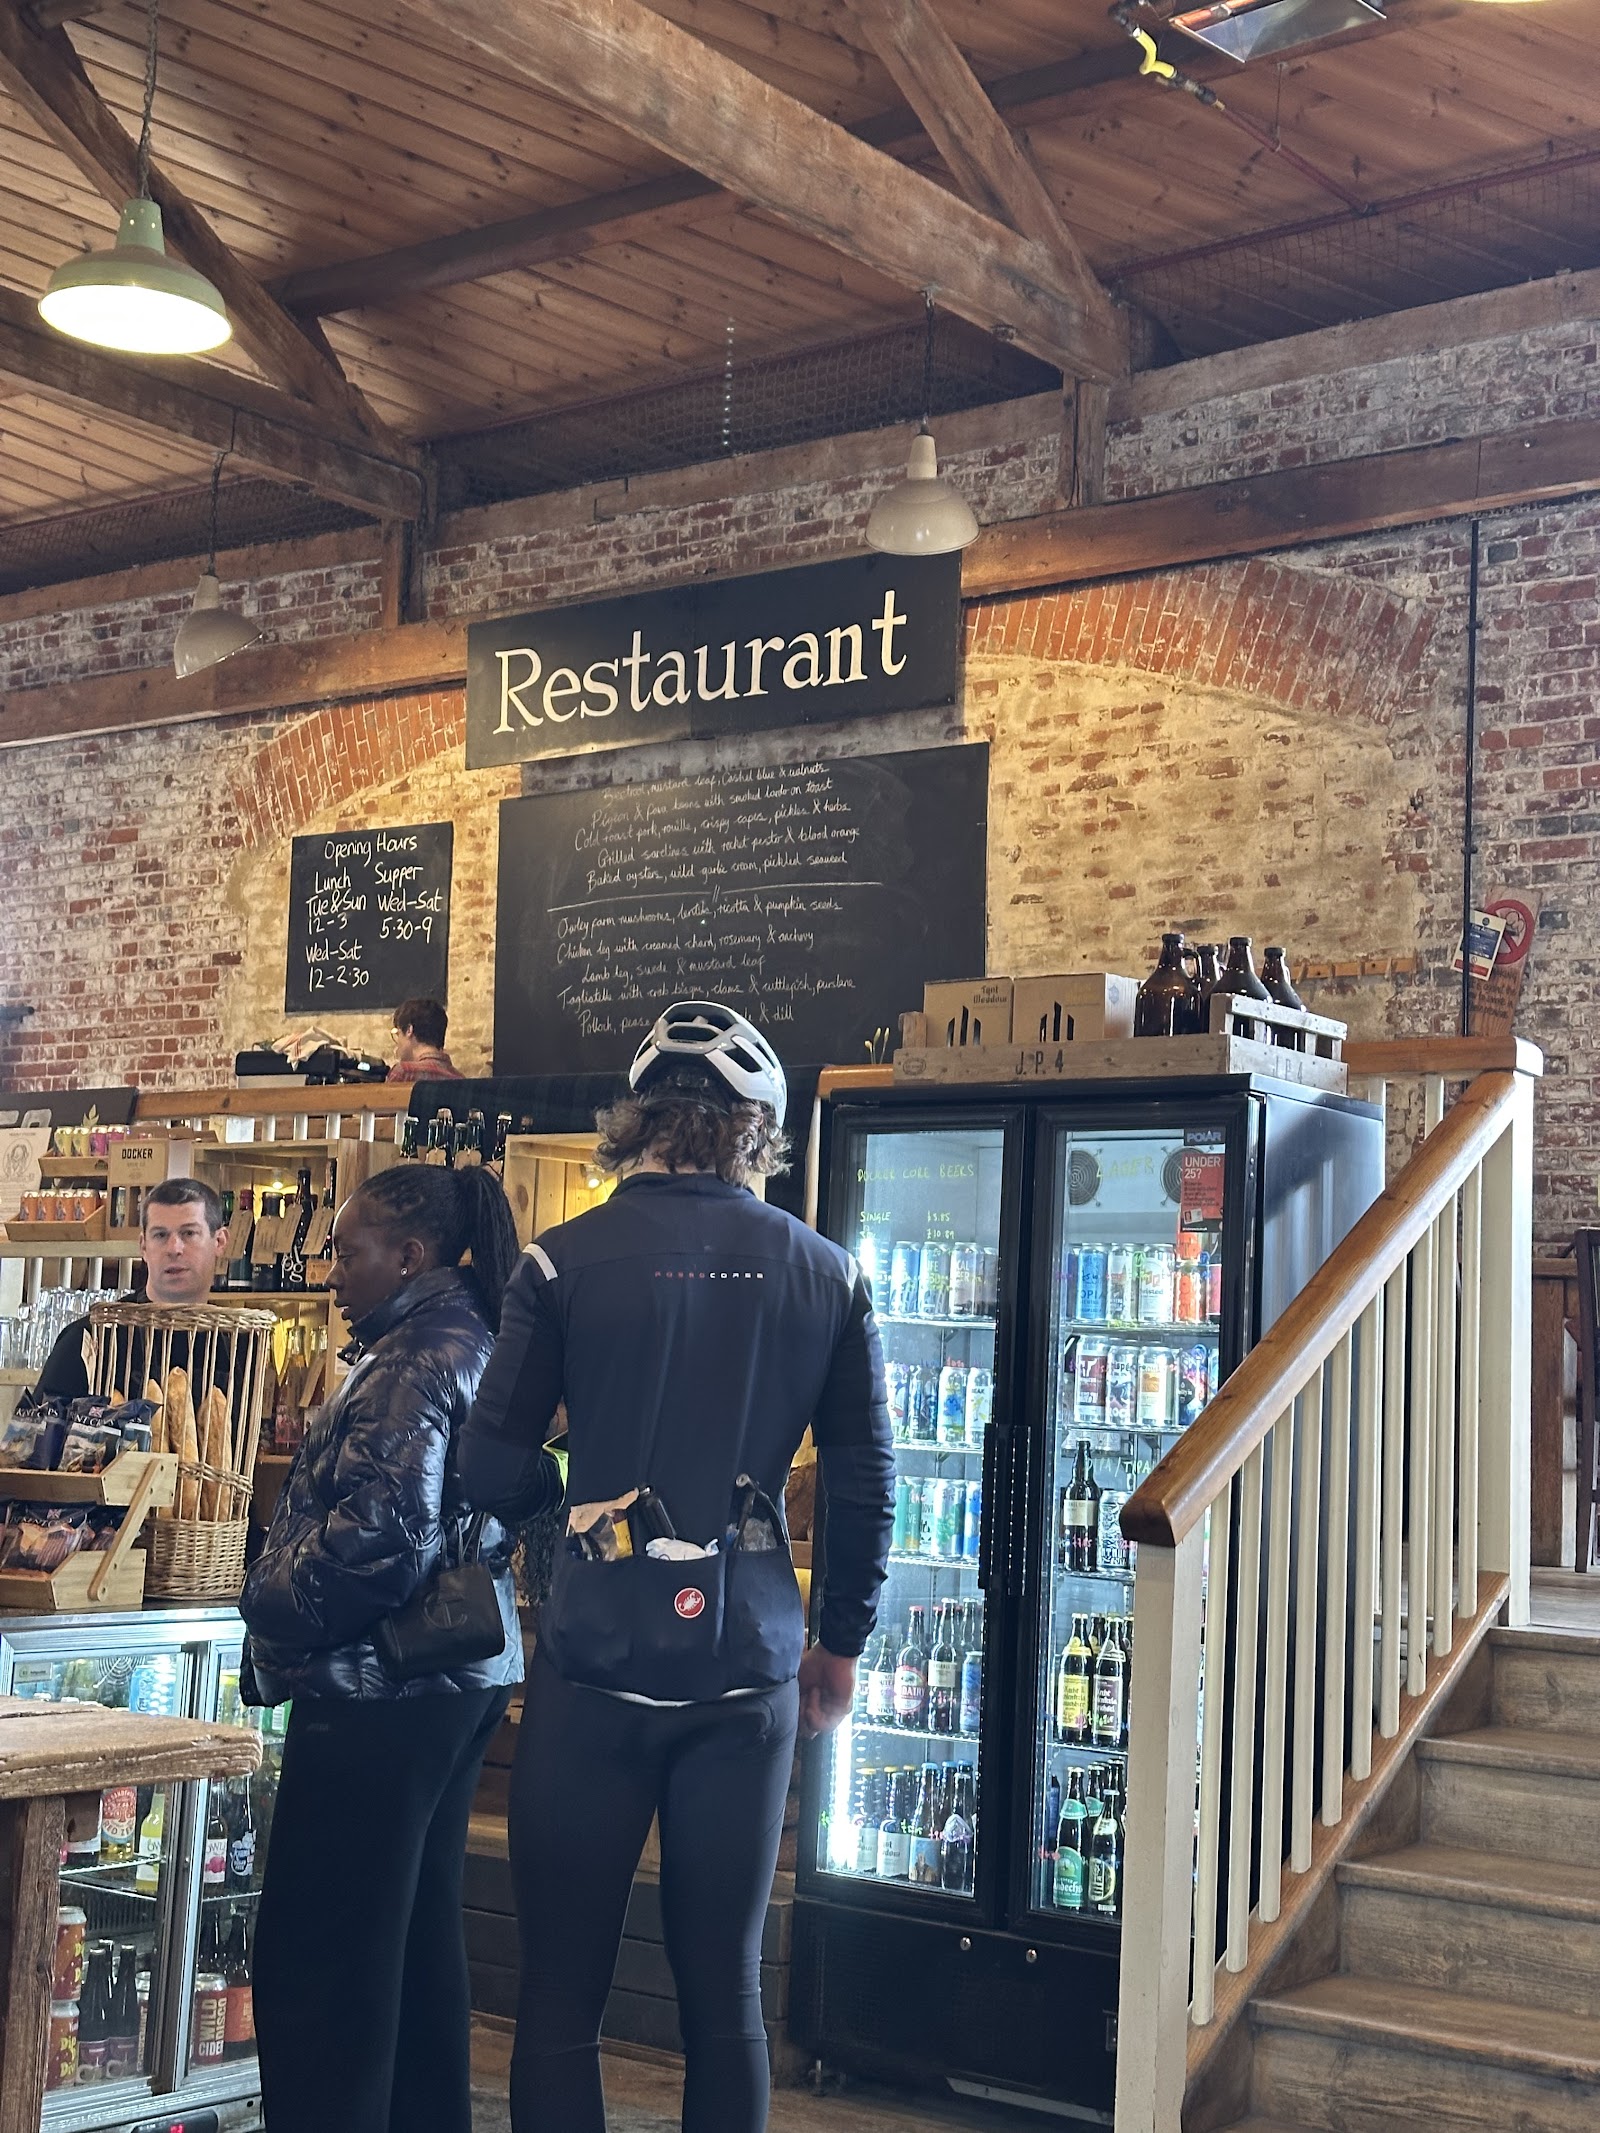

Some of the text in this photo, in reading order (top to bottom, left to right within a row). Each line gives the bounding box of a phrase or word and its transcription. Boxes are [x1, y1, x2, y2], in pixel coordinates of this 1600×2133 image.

[492, 589, 907, 735] Restaurant
[756, 766, 775, 780] blue
[778, 765, 787, 777] &
[591, 809, 629, 833] Pigeon
[633, 803, 644, 821] &
[704, 793, 725, 806] with
[729, 789, 761, 804] smoked
[791, 786, 801, 795] on
[805, 777, 833, 793] toast
[574, 827, 600, 850] Cold
[602, 824, 633, 843] roast
[636, 823, 661, 843] pork,
[700, 816, 730, 834] crispy
[774, 803, 810, 824] pickles
[812, 798, 821, 814] &
[823, 797, 851, 811] herbs
[324, 832, 418, 867] Opening Hours
[598, 825, 860, 868] Grilled sardines with rocket pesto & blood orange
[315, 867, 351, 893] Lunch
[374, 861, 423, 890] Supper
[586, 851, 848, 894] Baked oysters, wild garlic cream, pickled seaweed
[377, 888, 443, 912] Wed-Sat
[590, 917, 615, 938] farm
[619, 907, 675, 924] mushrooms,
[717, 897, 750, 913] ricotta
[754, 894, 763, 914] &
[765, 895, 806, 917] pumpkin
[809, 897, 843, 911] seeds
[305, 938, 363, 964] Wed-Sat
[556, 924, 814, 964] Chicken leg with creamed chard, rosemary & anchovy
[582, 963, 610, 984] Lamb
[614, 965, 634, 988] leg,
[676, 957, 685, 975] &
[688, 956, 736, 972] mustard
[741, 953, 766, 975] leaf
[617, 984, 643, 1000] with
[647, 981, 669, 997] crab
[671, 982, 710, 1000] bisque,
[711, 979, 744, 995] clams
[749, 973, 760, 995] &
[816, 973, 856, 991] purslane
[759, 1002, 770, 1024] &
[774, 1003, 794, 1021] dill
[1186, 1130, 1222, 1143] POLAR
[121, 1148, 153, 1159] DOCKER
[1185, 1156, 1221, 1168] UNDER
[939, 1163, 974, 1178] BEERS
[1184, 1167, 1202, 1179] 25?
[860, 1211, 892, 1223] SINGLE
[200, 1999, 218, 2040] WILD
[216, 1997, 228, 2040] DISCO
